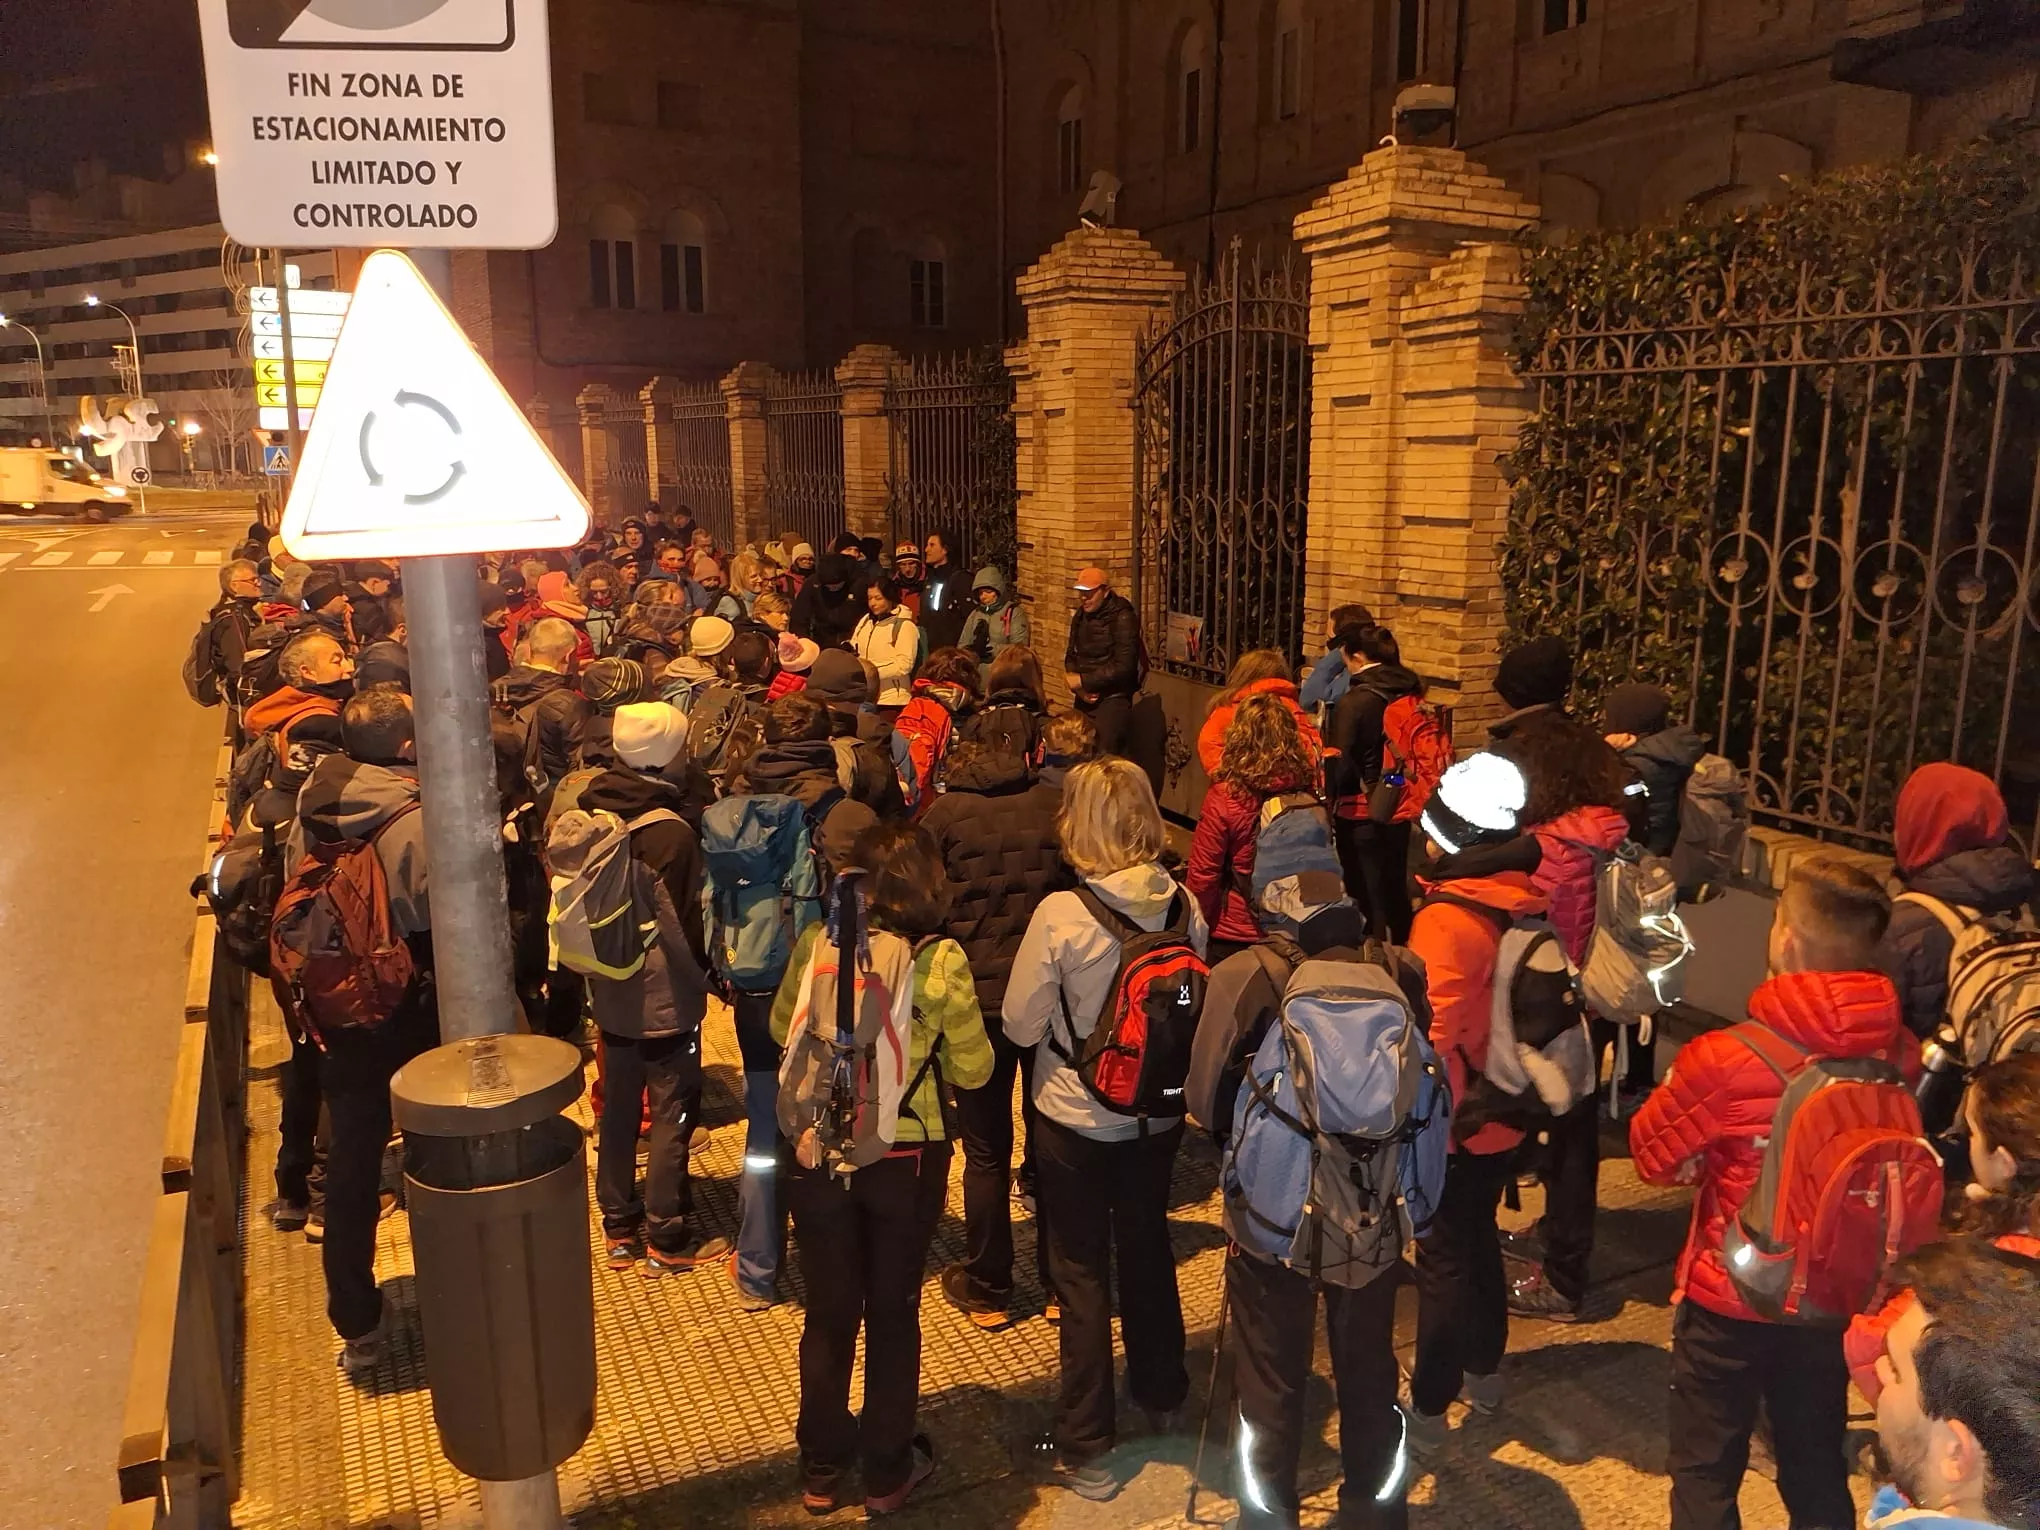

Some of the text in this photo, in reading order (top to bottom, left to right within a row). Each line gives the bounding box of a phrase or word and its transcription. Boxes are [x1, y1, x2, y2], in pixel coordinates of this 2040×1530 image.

[287, 72, 464, 98] FIN ZONA DE
[252, 116, 506, 142] ESTACIONAMIENTO
[312, 160, 463, 185] LIMITADO Y
[293, 203, 478, 228] CONTROLADO
